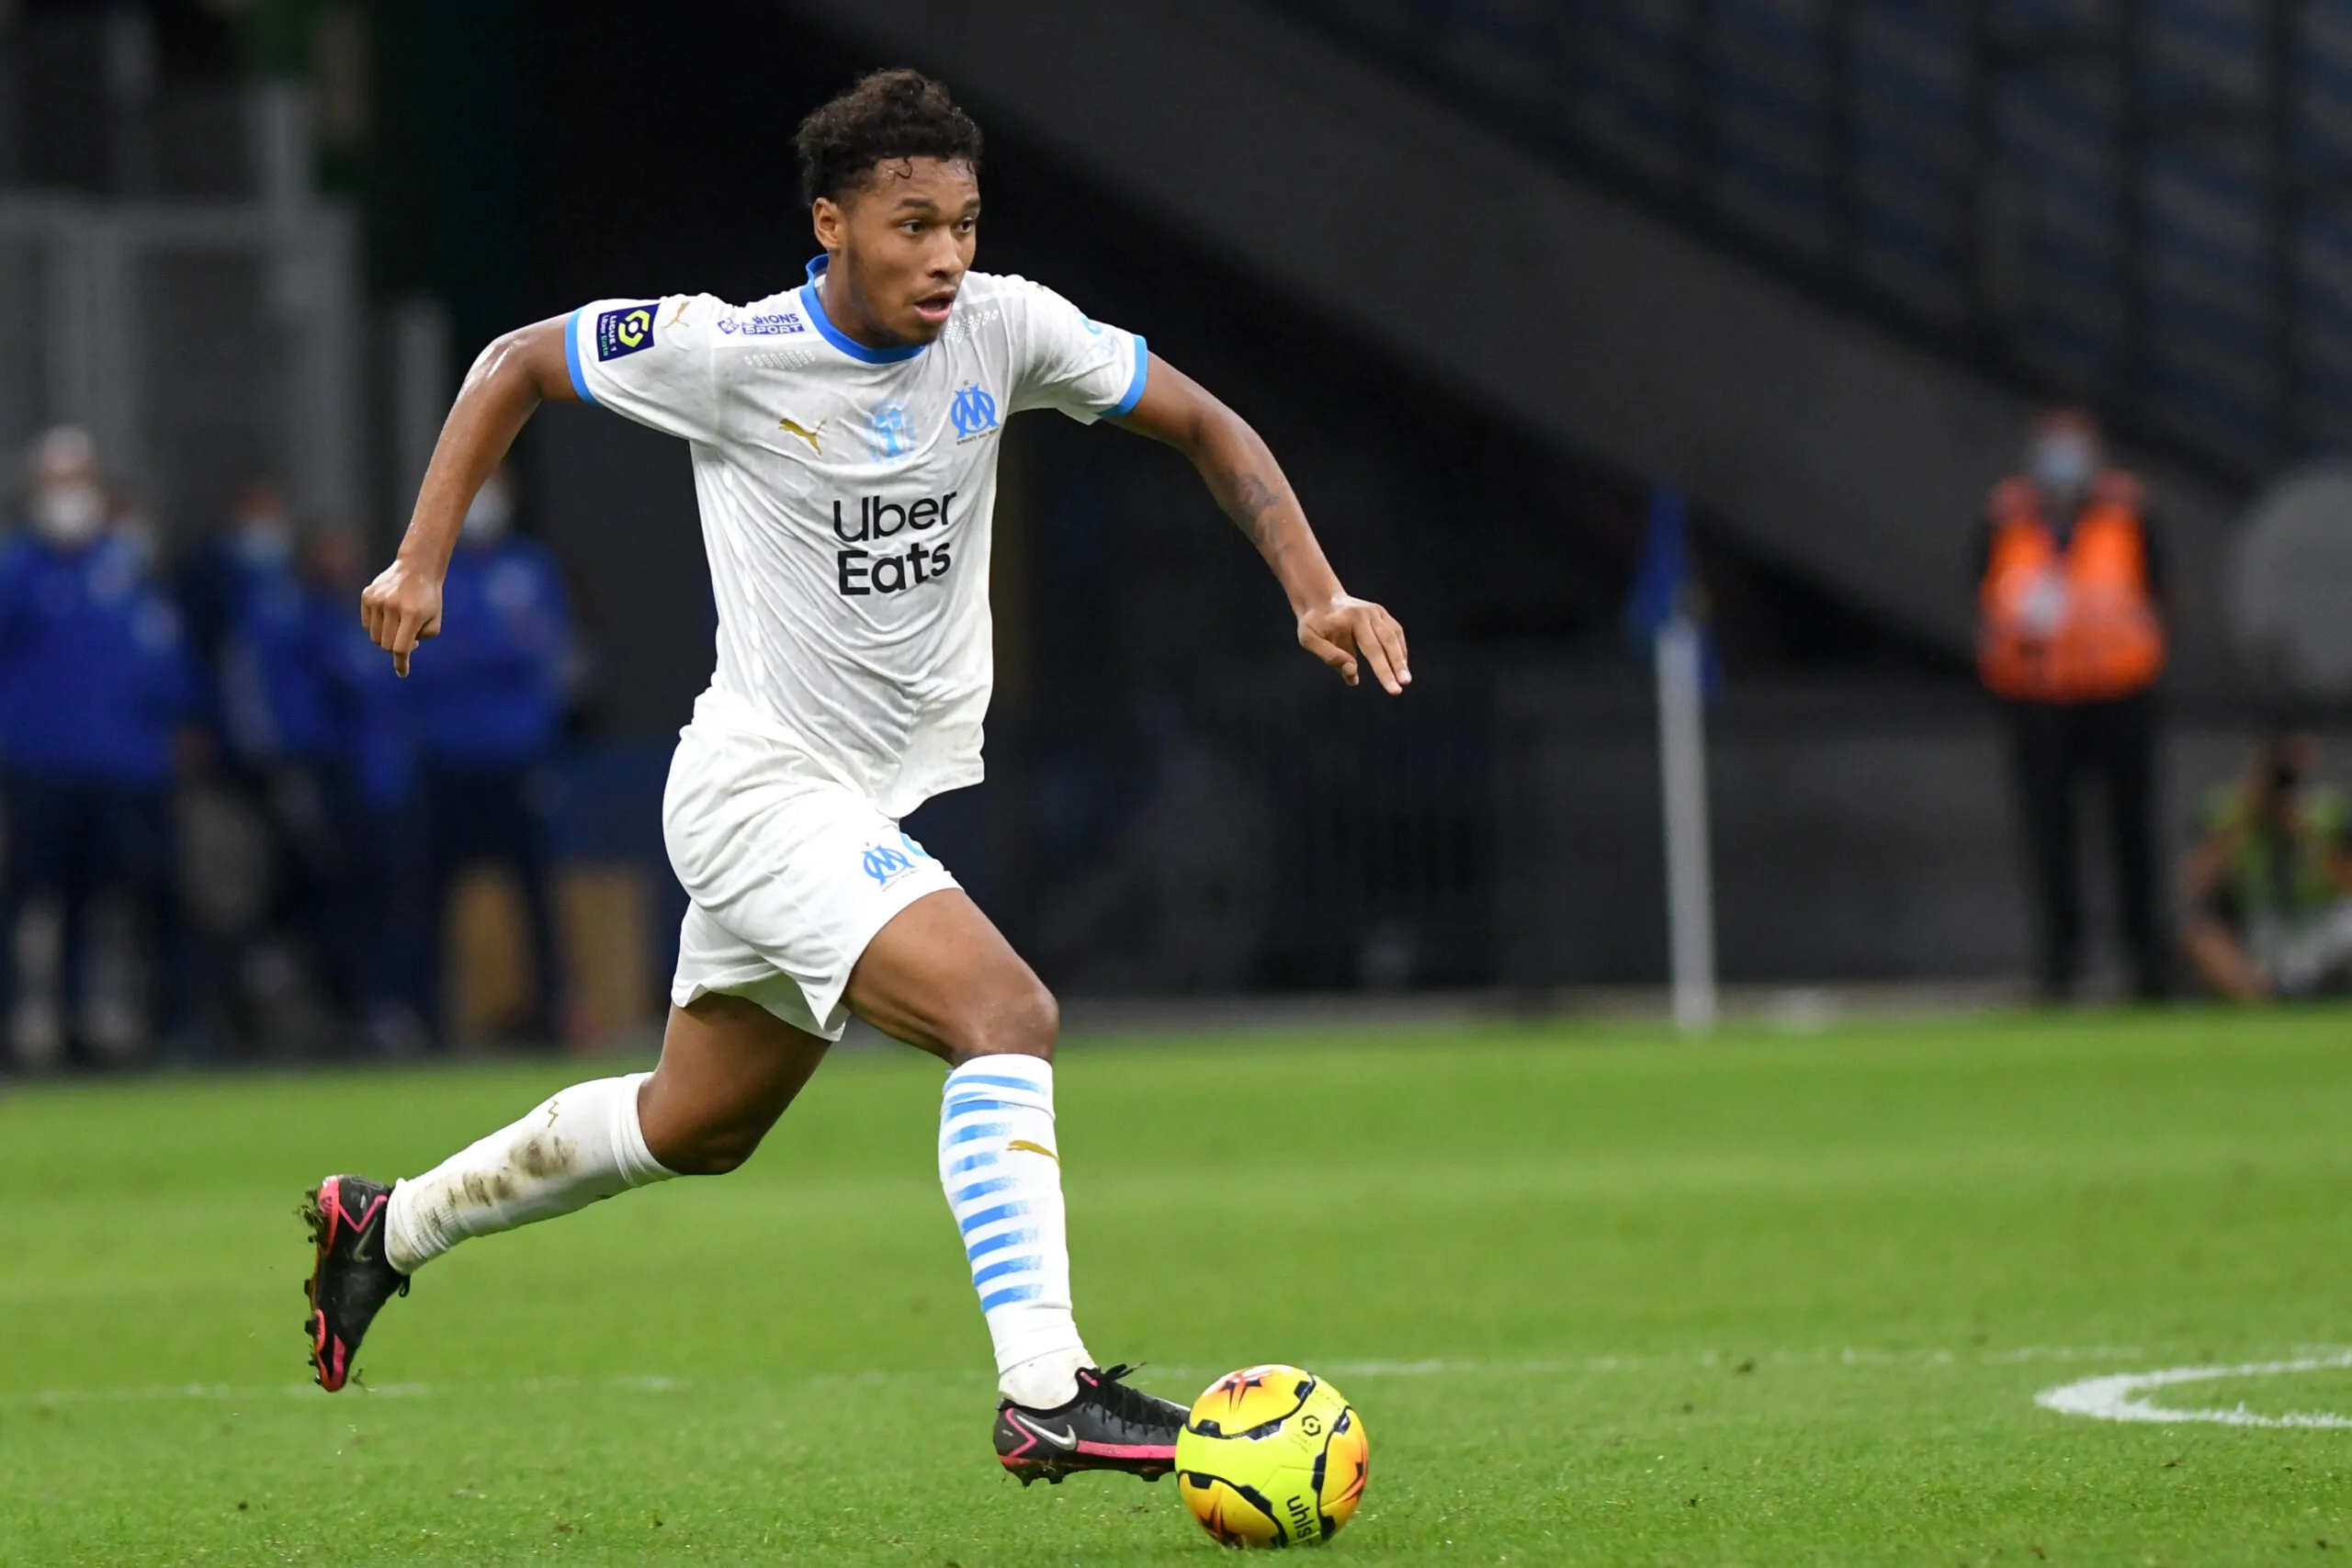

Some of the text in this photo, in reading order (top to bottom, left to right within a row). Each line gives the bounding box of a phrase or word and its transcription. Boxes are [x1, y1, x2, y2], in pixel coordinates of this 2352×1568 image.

[608, 315, 617, 344] LIGUE
[744, 324, 800, 334] SPORT
[833, 491, 957, 543] Uber
[837, 542, 951, 595] Eats
